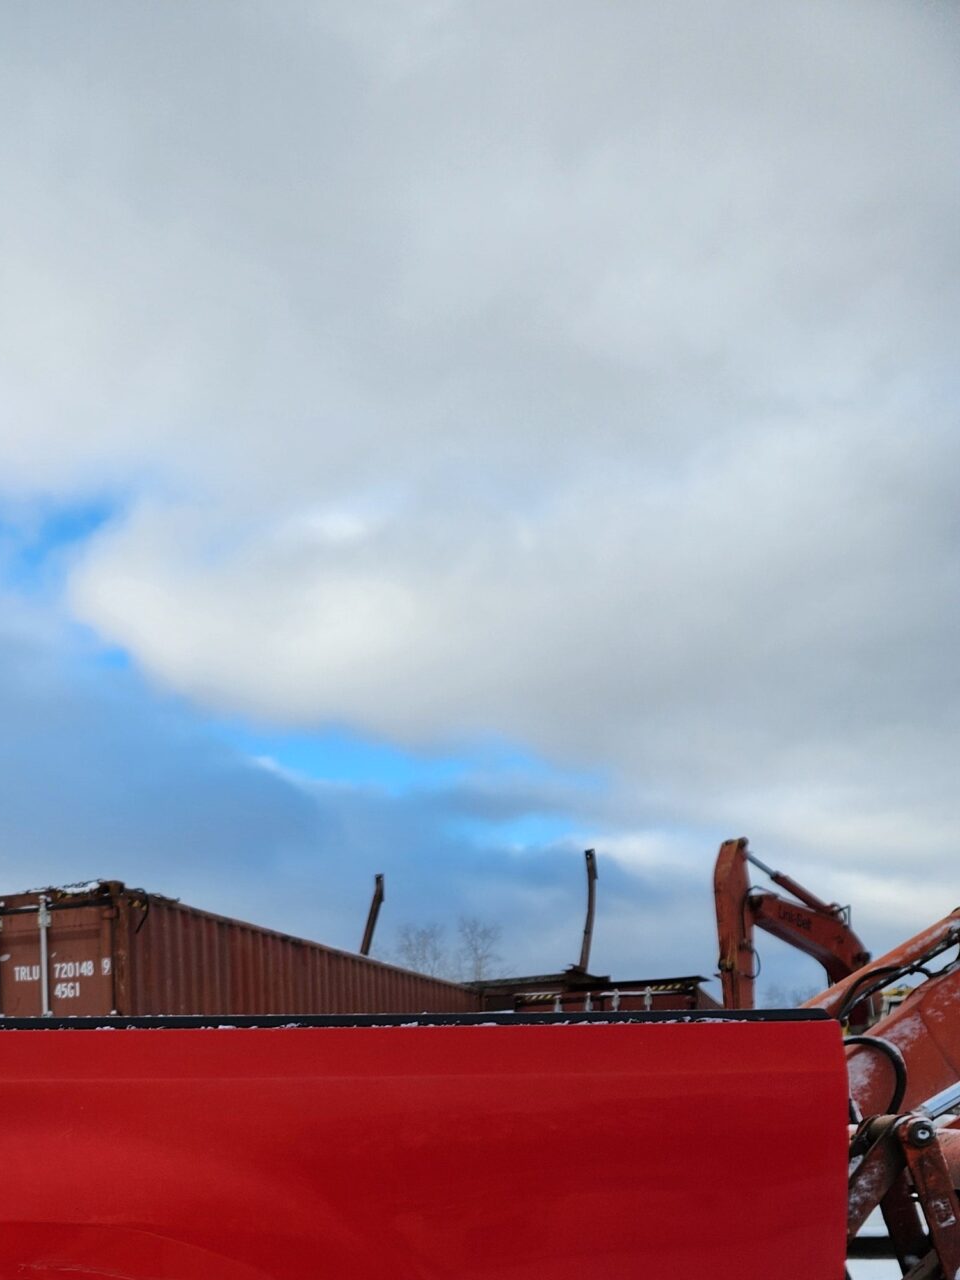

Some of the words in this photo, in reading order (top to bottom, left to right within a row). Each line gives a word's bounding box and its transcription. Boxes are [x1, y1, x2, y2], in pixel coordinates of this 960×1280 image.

[14, 965, 40, 981] TRLU
[53, 960, 95, 979] 720148
[102, 957, 111, 976] 9
[54, 982, 80, 998] 45G1
